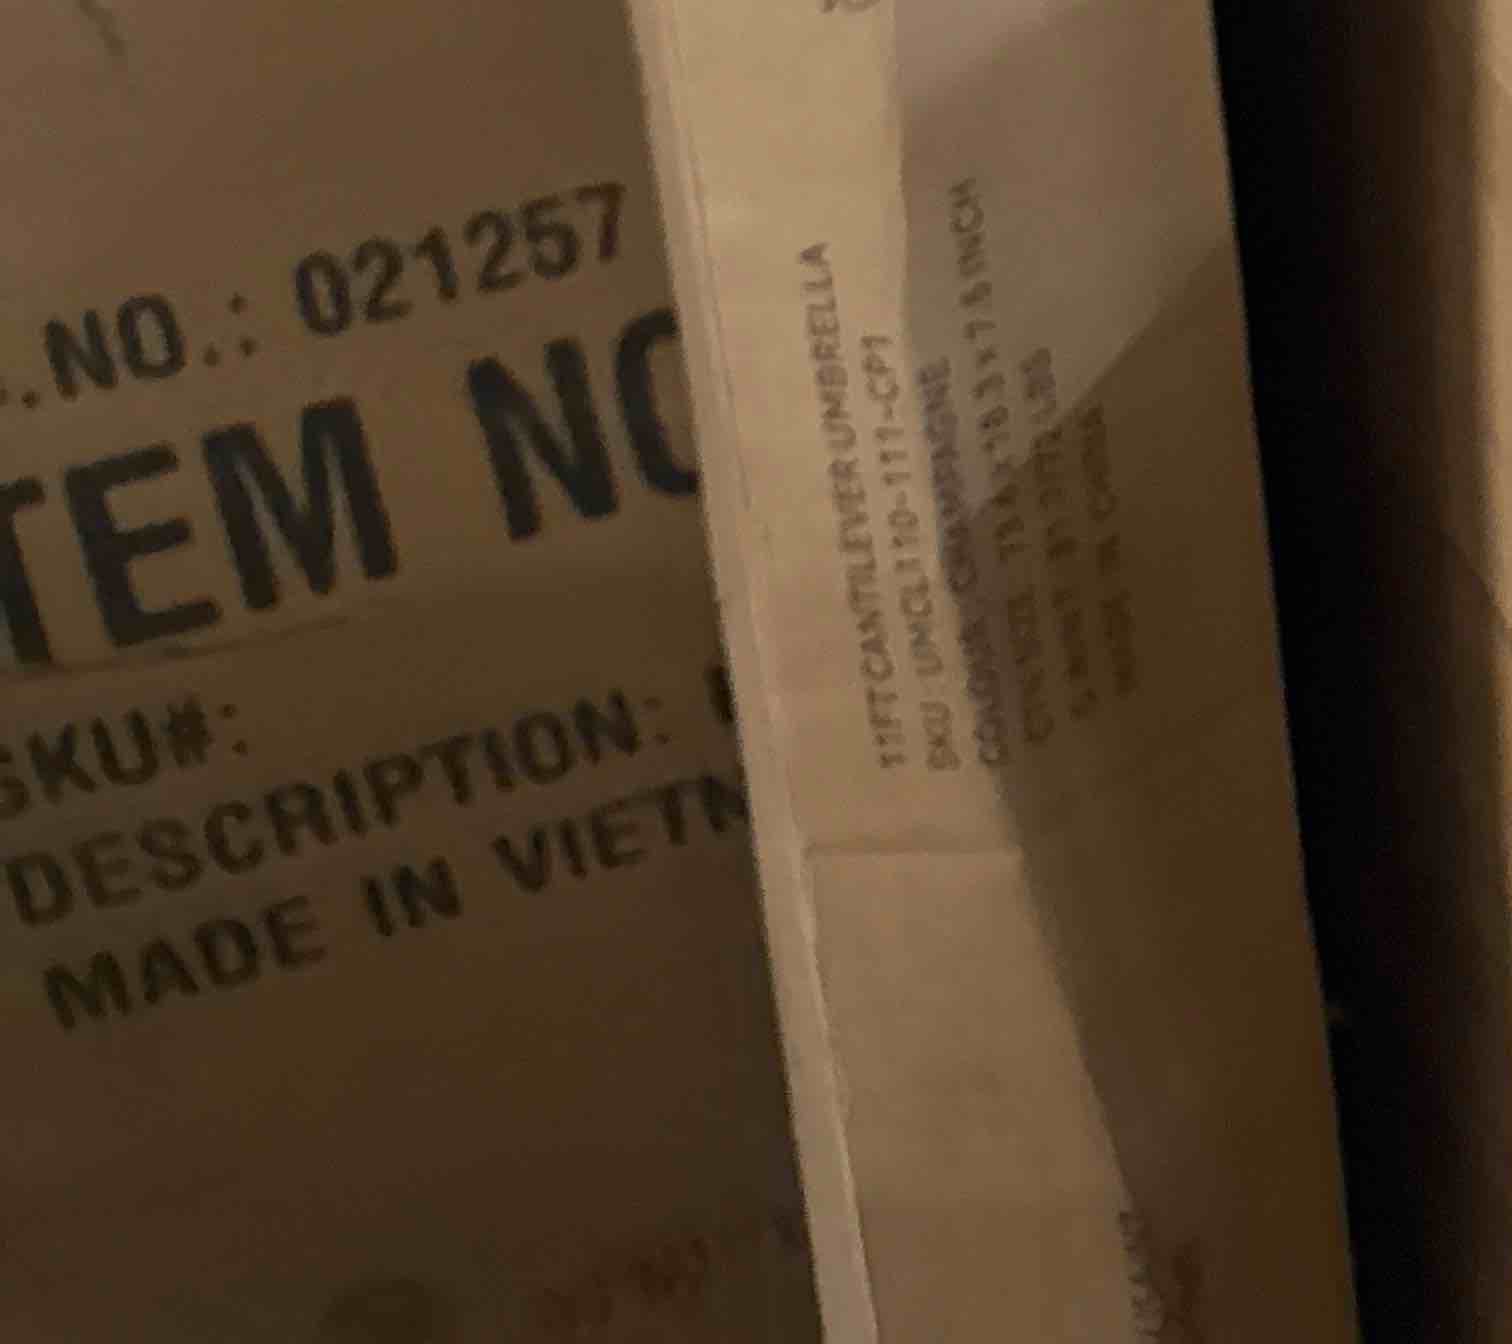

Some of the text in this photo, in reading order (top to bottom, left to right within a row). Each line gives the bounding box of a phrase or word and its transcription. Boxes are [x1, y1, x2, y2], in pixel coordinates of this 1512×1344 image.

[0, 180, 627, 404] .NO.: 021257
[798, 242, 858, 452] UMBRELLA
[6, 688, 670, 928] DESCRIPTION:
[42, 896, 328, 1032] MADE
[361, 858, 464, 938] IN
